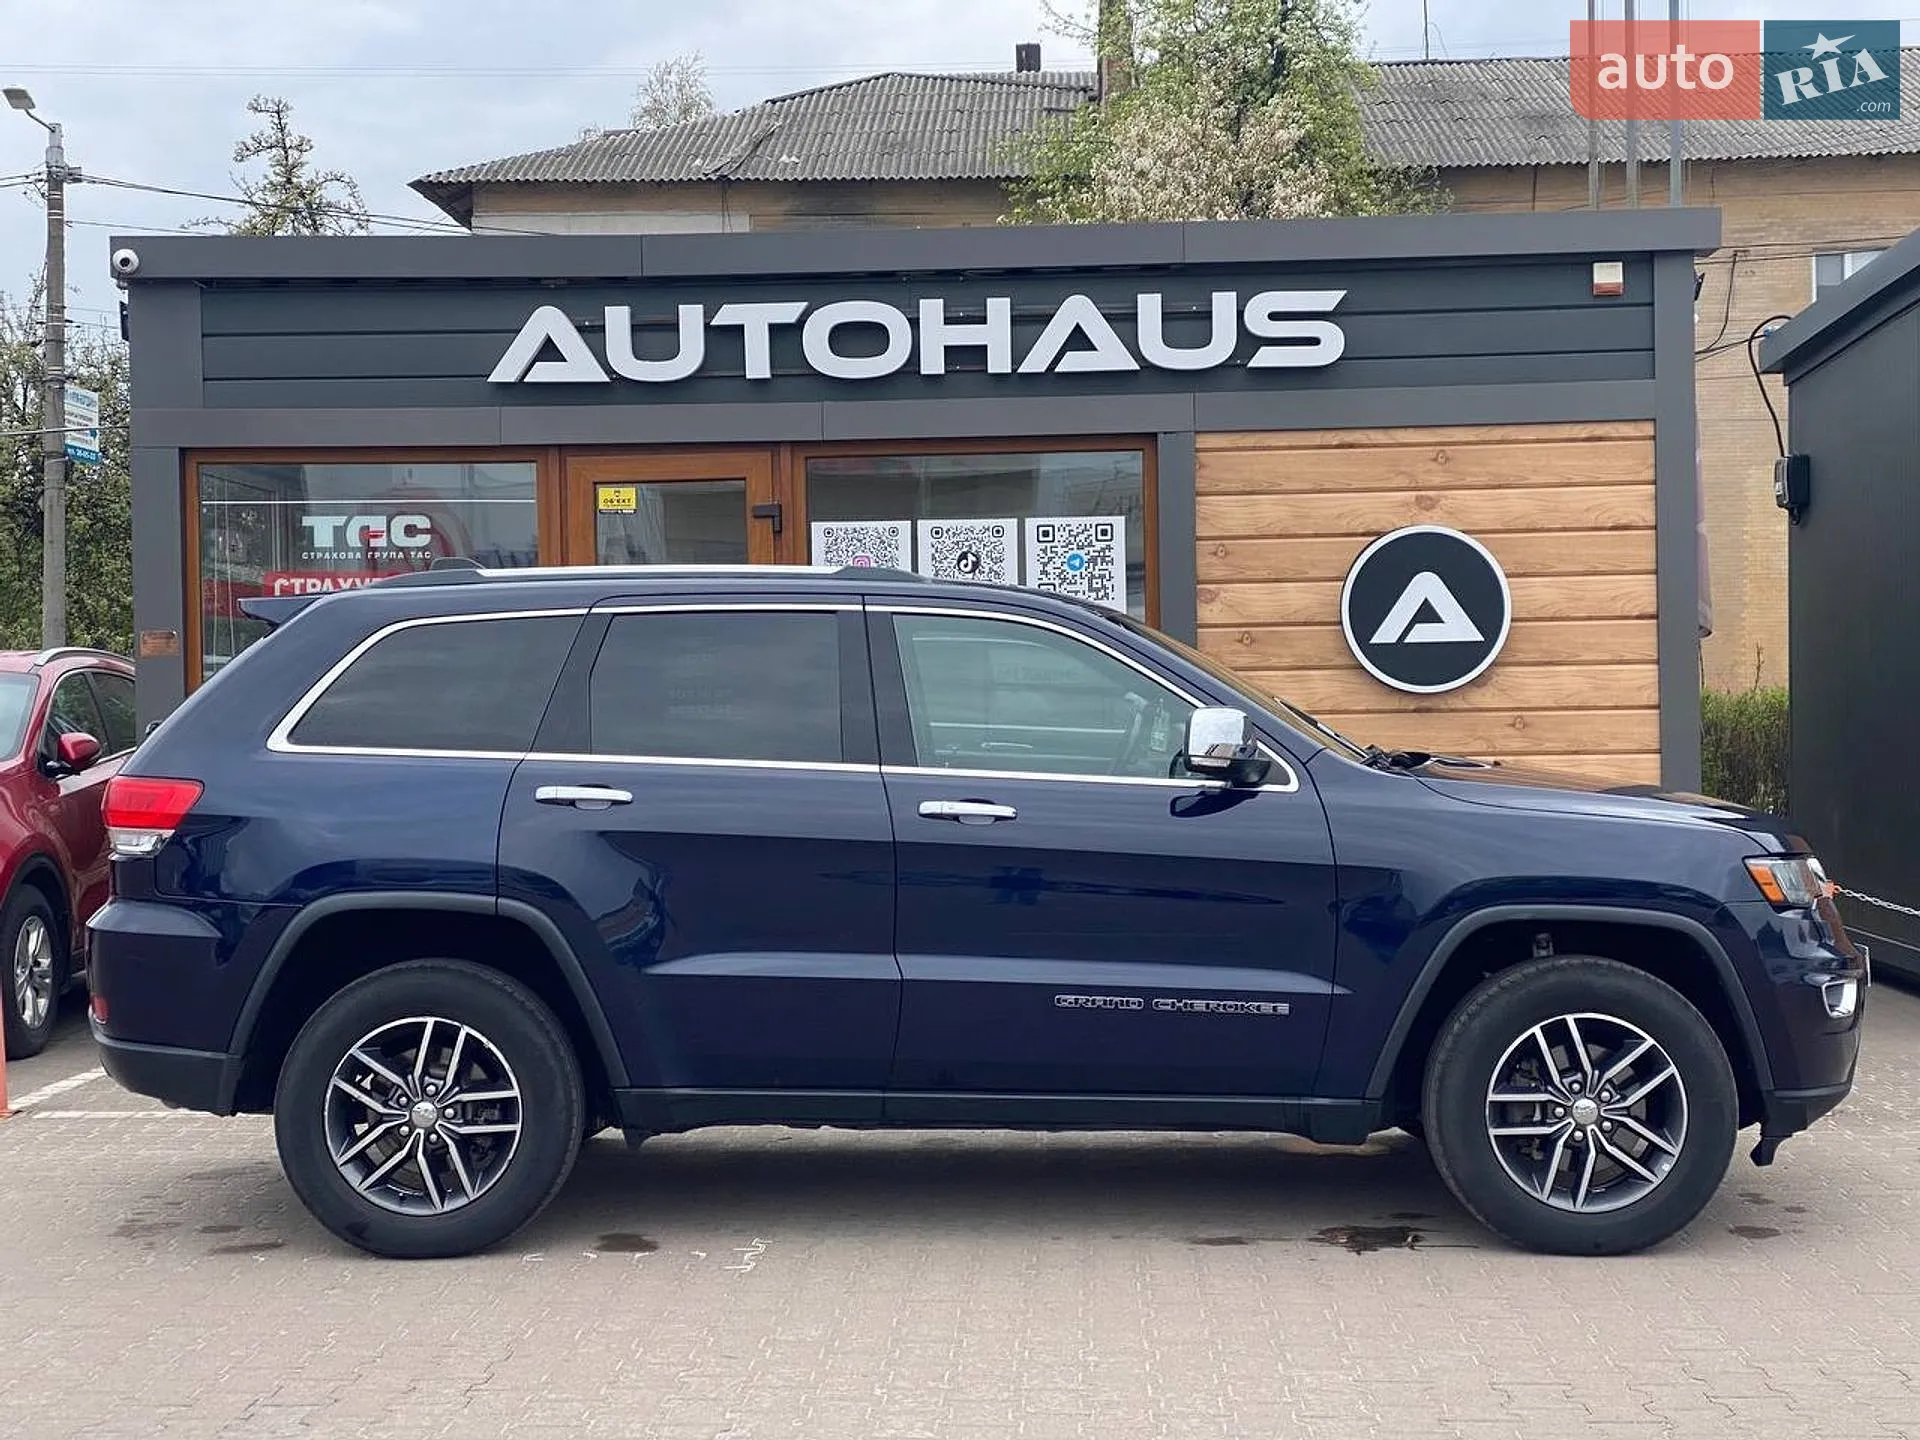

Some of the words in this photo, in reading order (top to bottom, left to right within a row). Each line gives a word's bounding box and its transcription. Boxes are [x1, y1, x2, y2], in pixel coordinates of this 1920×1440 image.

[486, 289, 1349, 384] AUTOHAUS
[301, 551, 362, 560] СТРАХОВА
[367, 551, 405, 560] ГРУПА
[409, 551, 432, 560] ТАС
[1054, 994, 1145, 1010] GRAND
[1151, 998, 1290, 1016] CHEROKEE
